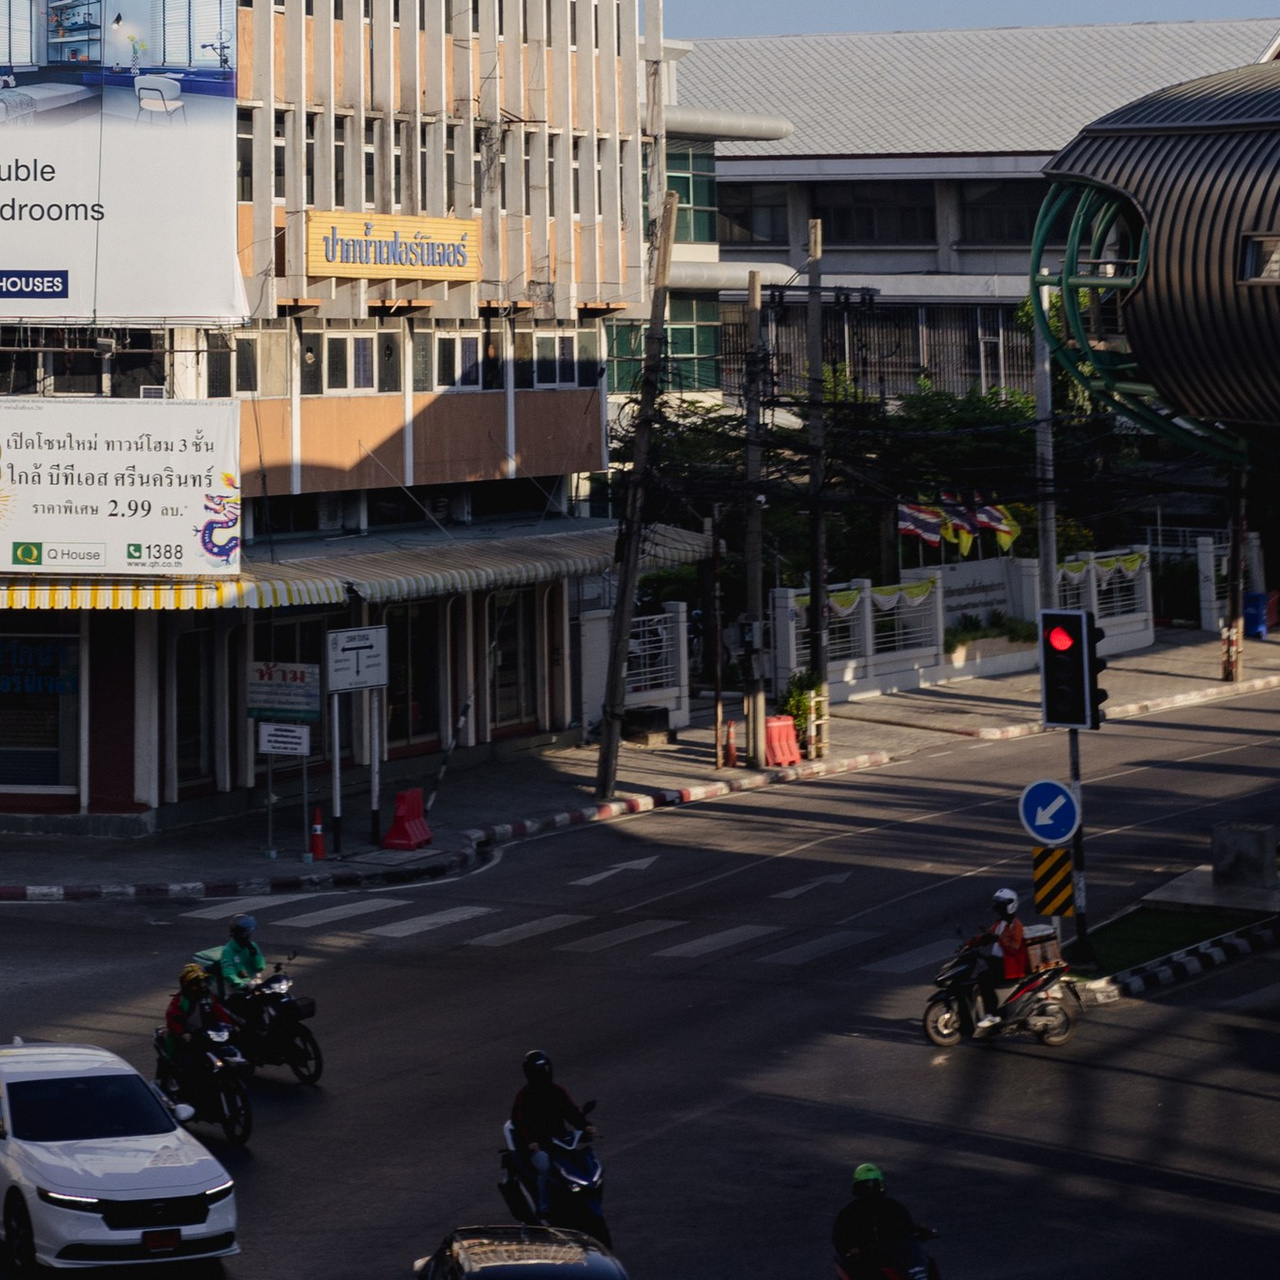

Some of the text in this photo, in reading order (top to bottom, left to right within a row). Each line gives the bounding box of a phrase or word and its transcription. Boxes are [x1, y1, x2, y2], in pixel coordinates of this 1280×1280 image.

[7, 429, 214, 452] เปิดโซนใหม่ ทาวน์โฮม 3 ชั้น
[7, 463, 214, 488] ใกล้ บีทีเอส ศรีนครินทร์
[32, 500, 99, 515] ราคาพิเศษ
[108, 500, 152, 517] 2.99
[47, 549, 100, 560] Q House
[146, 544, 183, 559] 1388
[255, 662, 306, 683] ห้าม
